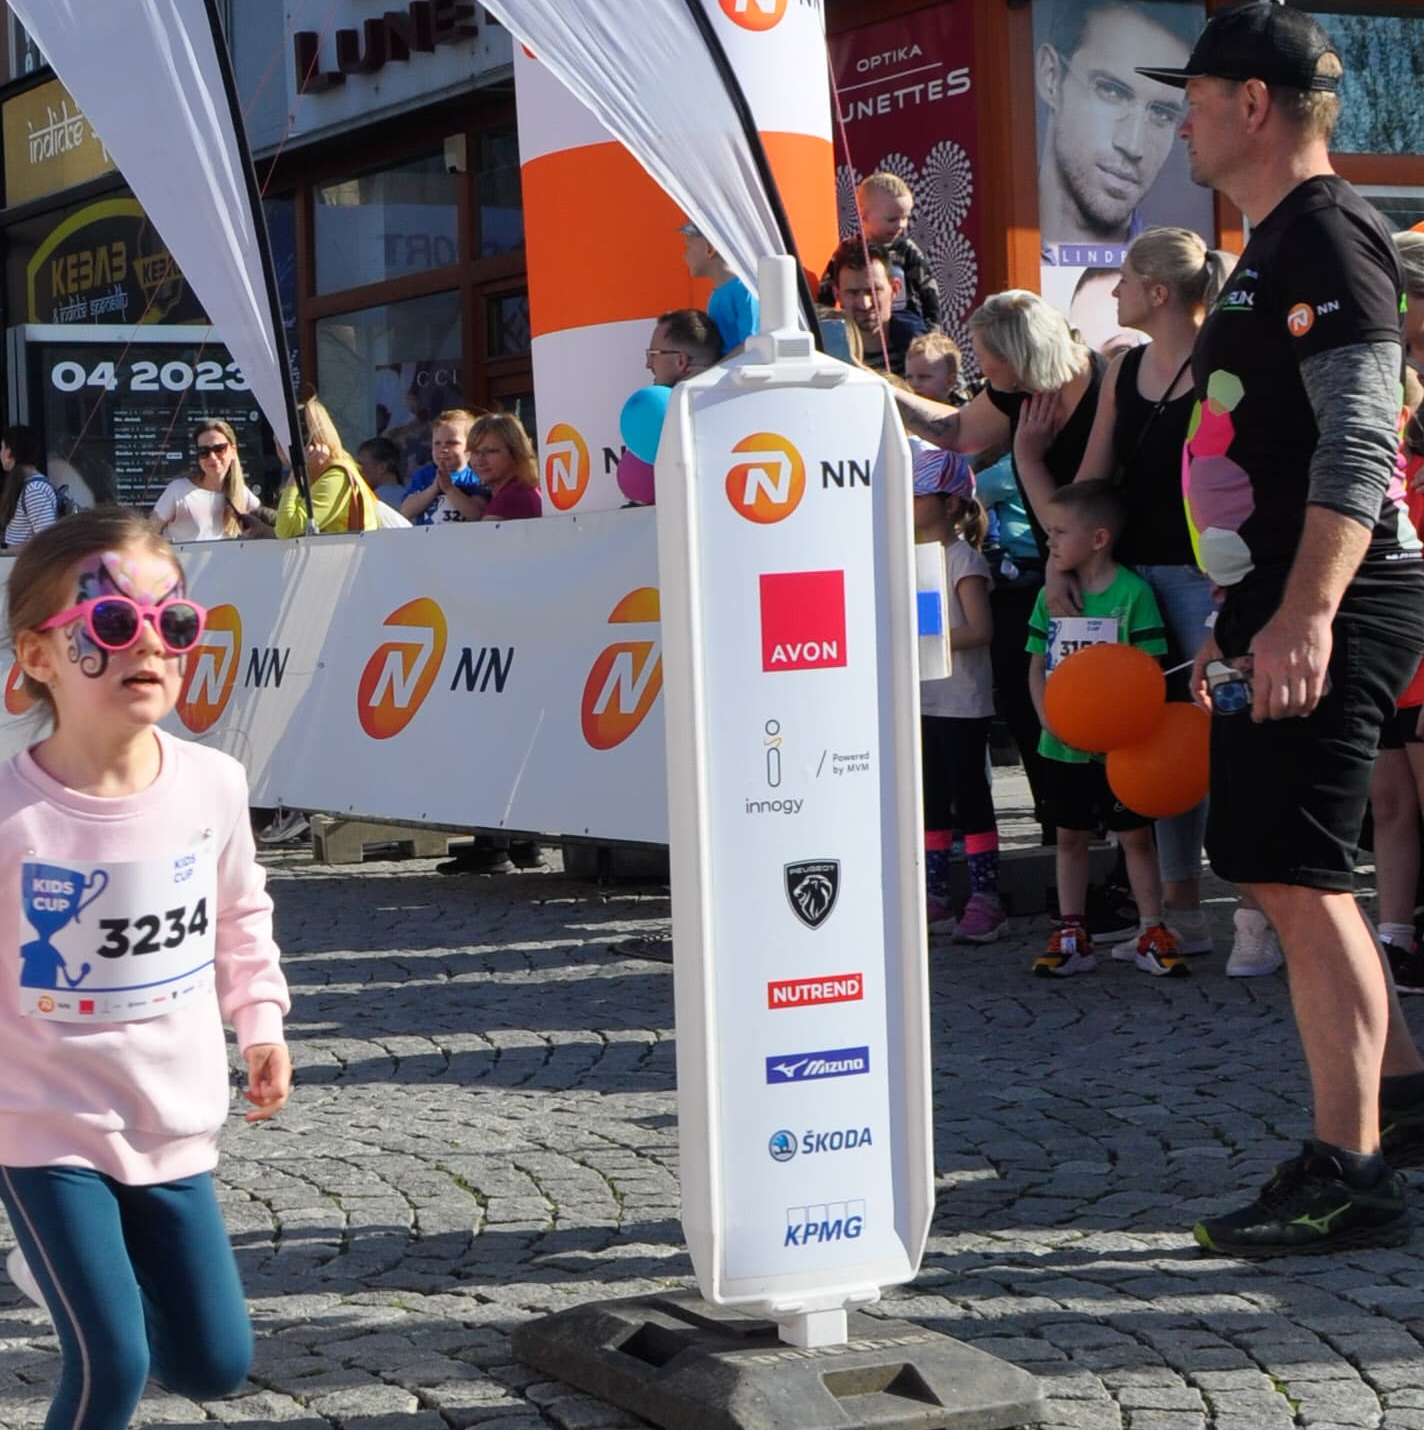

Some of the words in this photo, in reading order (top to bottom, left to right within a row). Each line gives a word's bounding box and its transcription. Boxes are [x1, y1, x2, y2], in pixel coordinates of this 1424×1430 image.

[856, 44, 923, 73] OPTIKA
[836, 67, 972, 124] UNETTES
[1316, 299, 1341, 316] NN
[51, 360, 119, 393] 04
[416, 368, 458, 388] CCI
[602, 446, 627, 475] N
[821, 458, 873, 490] NN
[770, 639, 838, 664] AVON
[1060, 640, 1109, 657] 31
[244, 647, 291, 689] NN
[450, 646, 515, 694] NN
[832, 750, 870, 763] Powered
[745, 797, 804, 815] innogy
[789, 864, 836, 875] PEUGEOT
[32, 878, 75, 895] KIDS
[32, 897, 71, 913] CUP
[96, 896, 209, 960] 3234
[772, 978, 860, 1004] NUTREND
[801, 1127, 873, 1155] ŠKODA
[783, 1215, 863, 1248] KPMG
